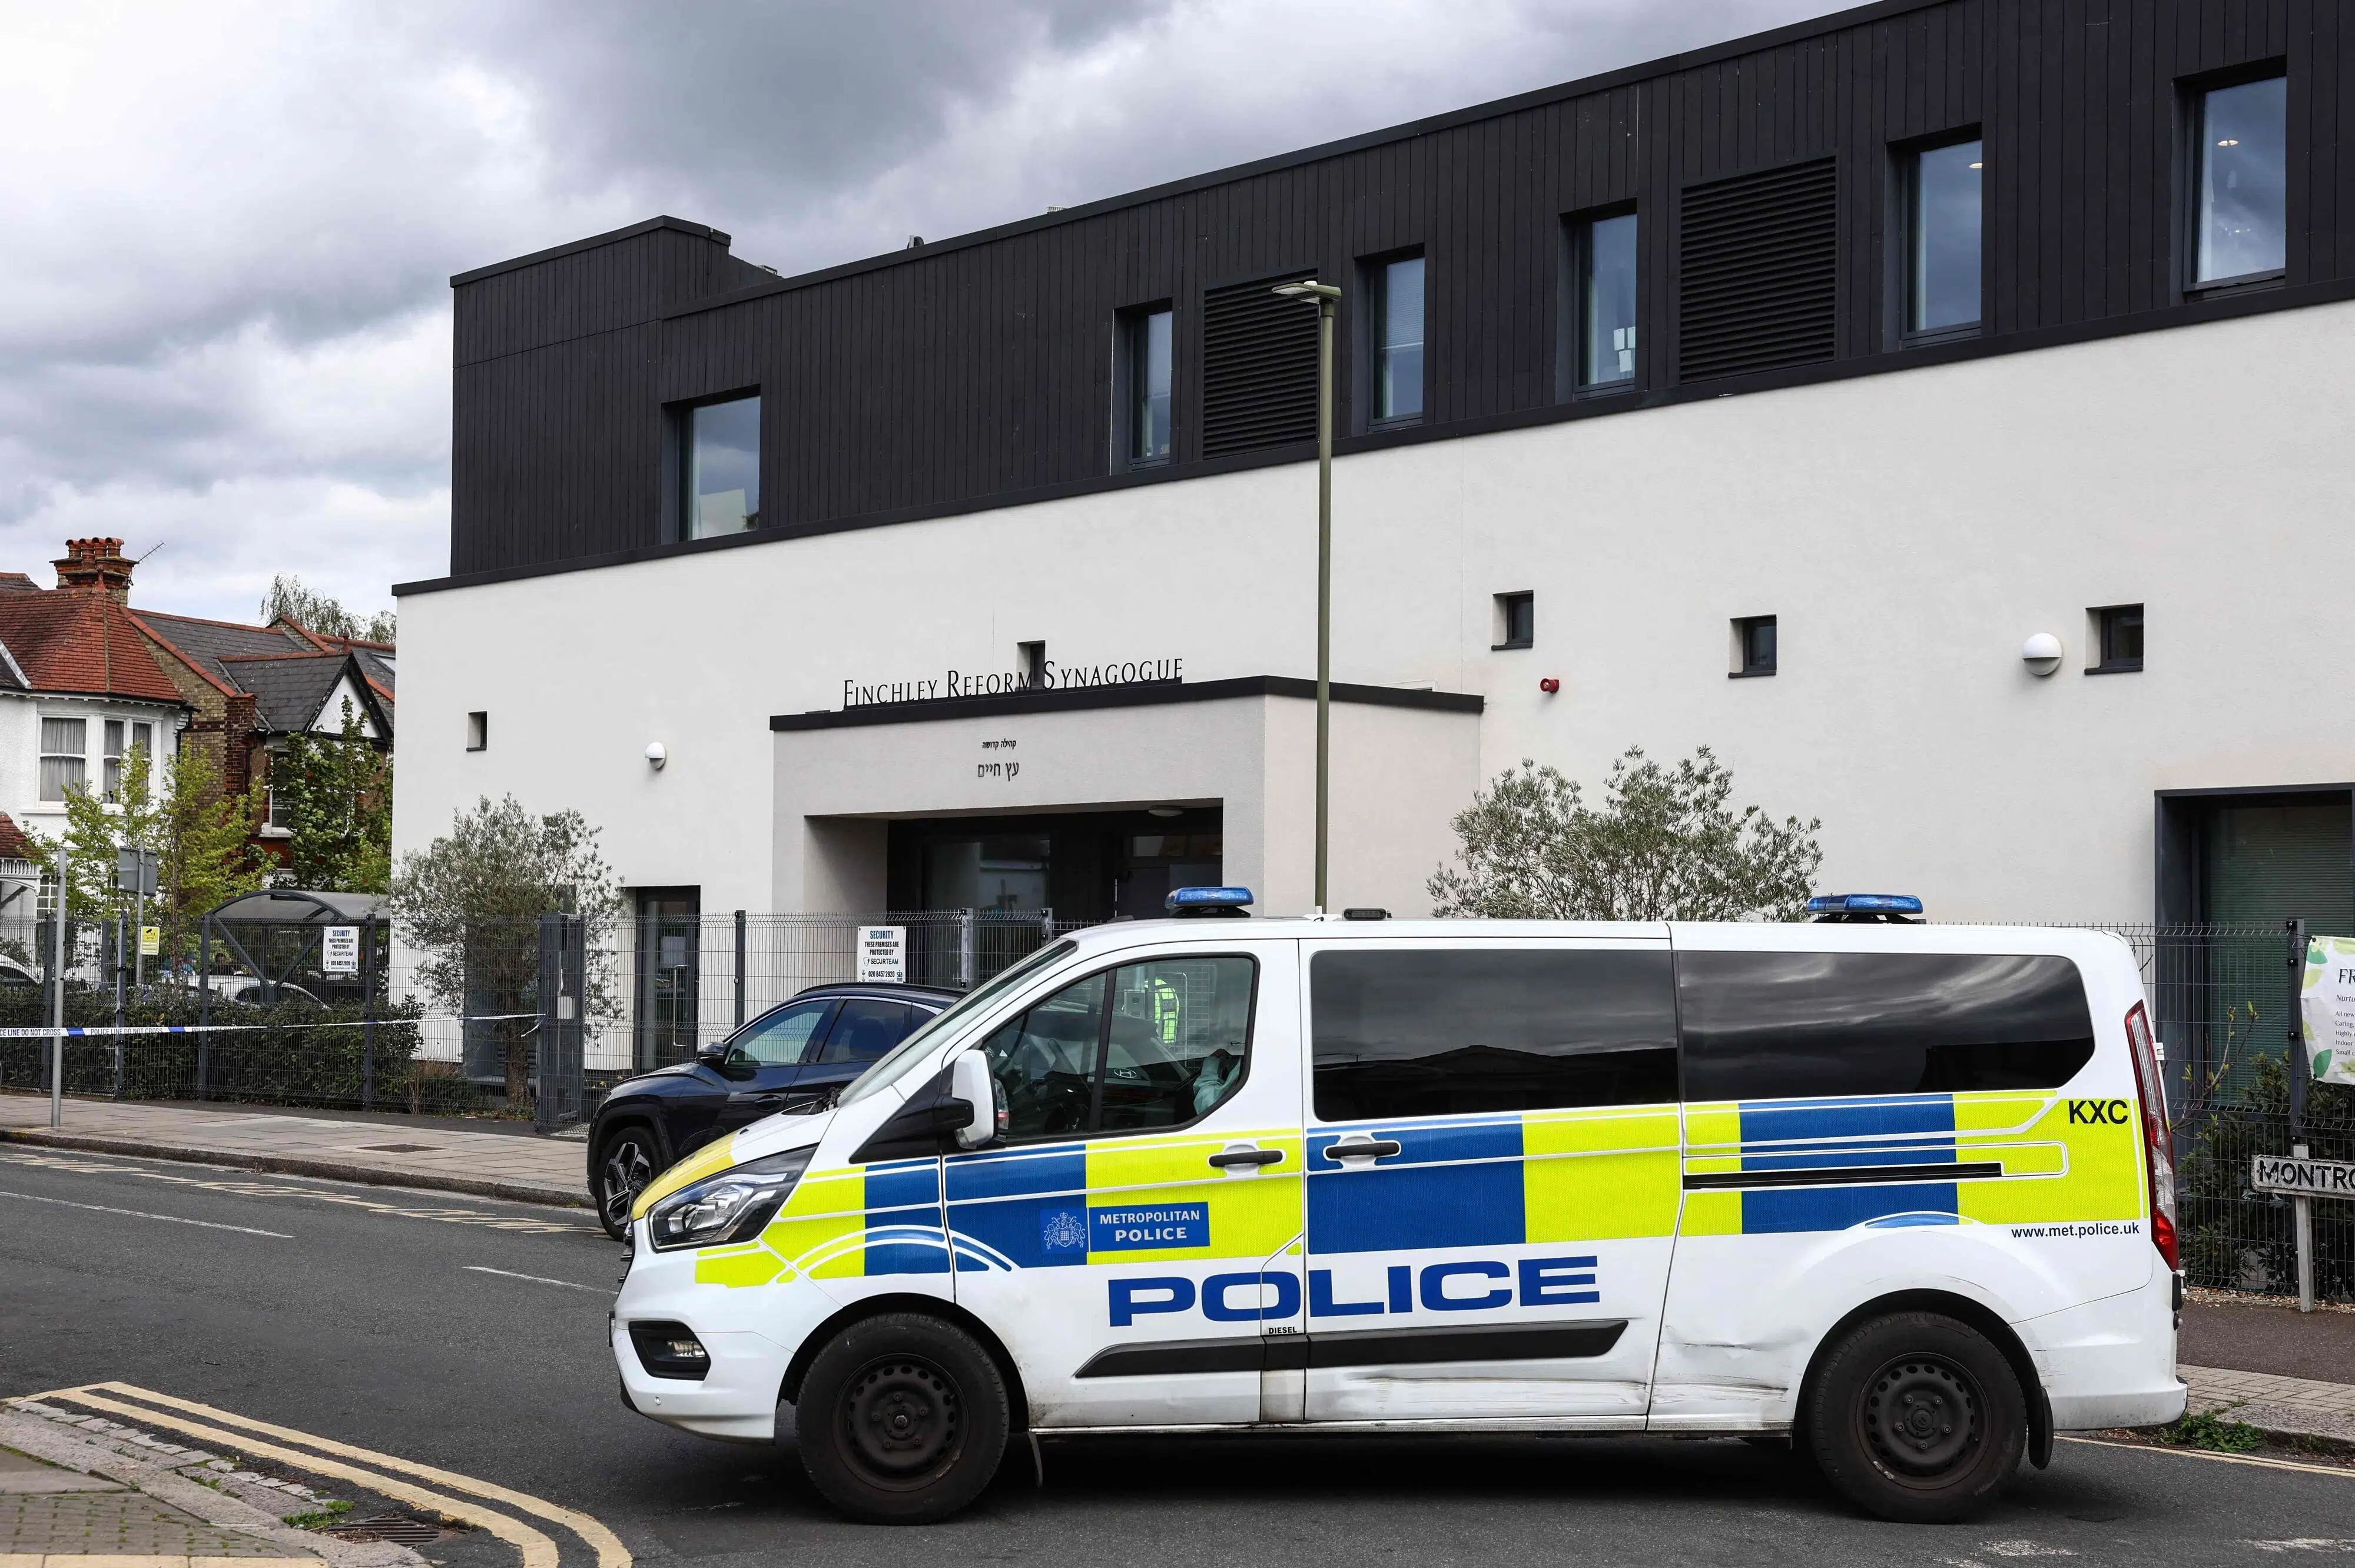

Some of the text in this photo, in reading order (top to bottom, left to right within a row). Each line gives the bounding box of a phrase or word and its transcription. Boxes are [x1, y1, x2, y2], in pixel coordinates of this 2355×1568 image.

[844, 658, 1183, 706] FINCHLEY REFORM SYNAGOGUE
[982, 738, 1017, 751] קהילה קדושה
[977, 762, 1019, 782] עץ חיים
[870, 931, 894, 939] SECURITY
[2335, 1020, 2354, 1029] Caring,
[2068, 1099, 2128, 1125] KXC
[1099, 1210, 1200, 1225] METROPOLITAN
[1115, 1227, 1188, 1242] POLICE
[2011, 1221, 2140, 1238] www.met.police.uk
[1107, 1255, 1601, 1327] POLICE
[1268, 1326, 1298, 1334] DIESEL
